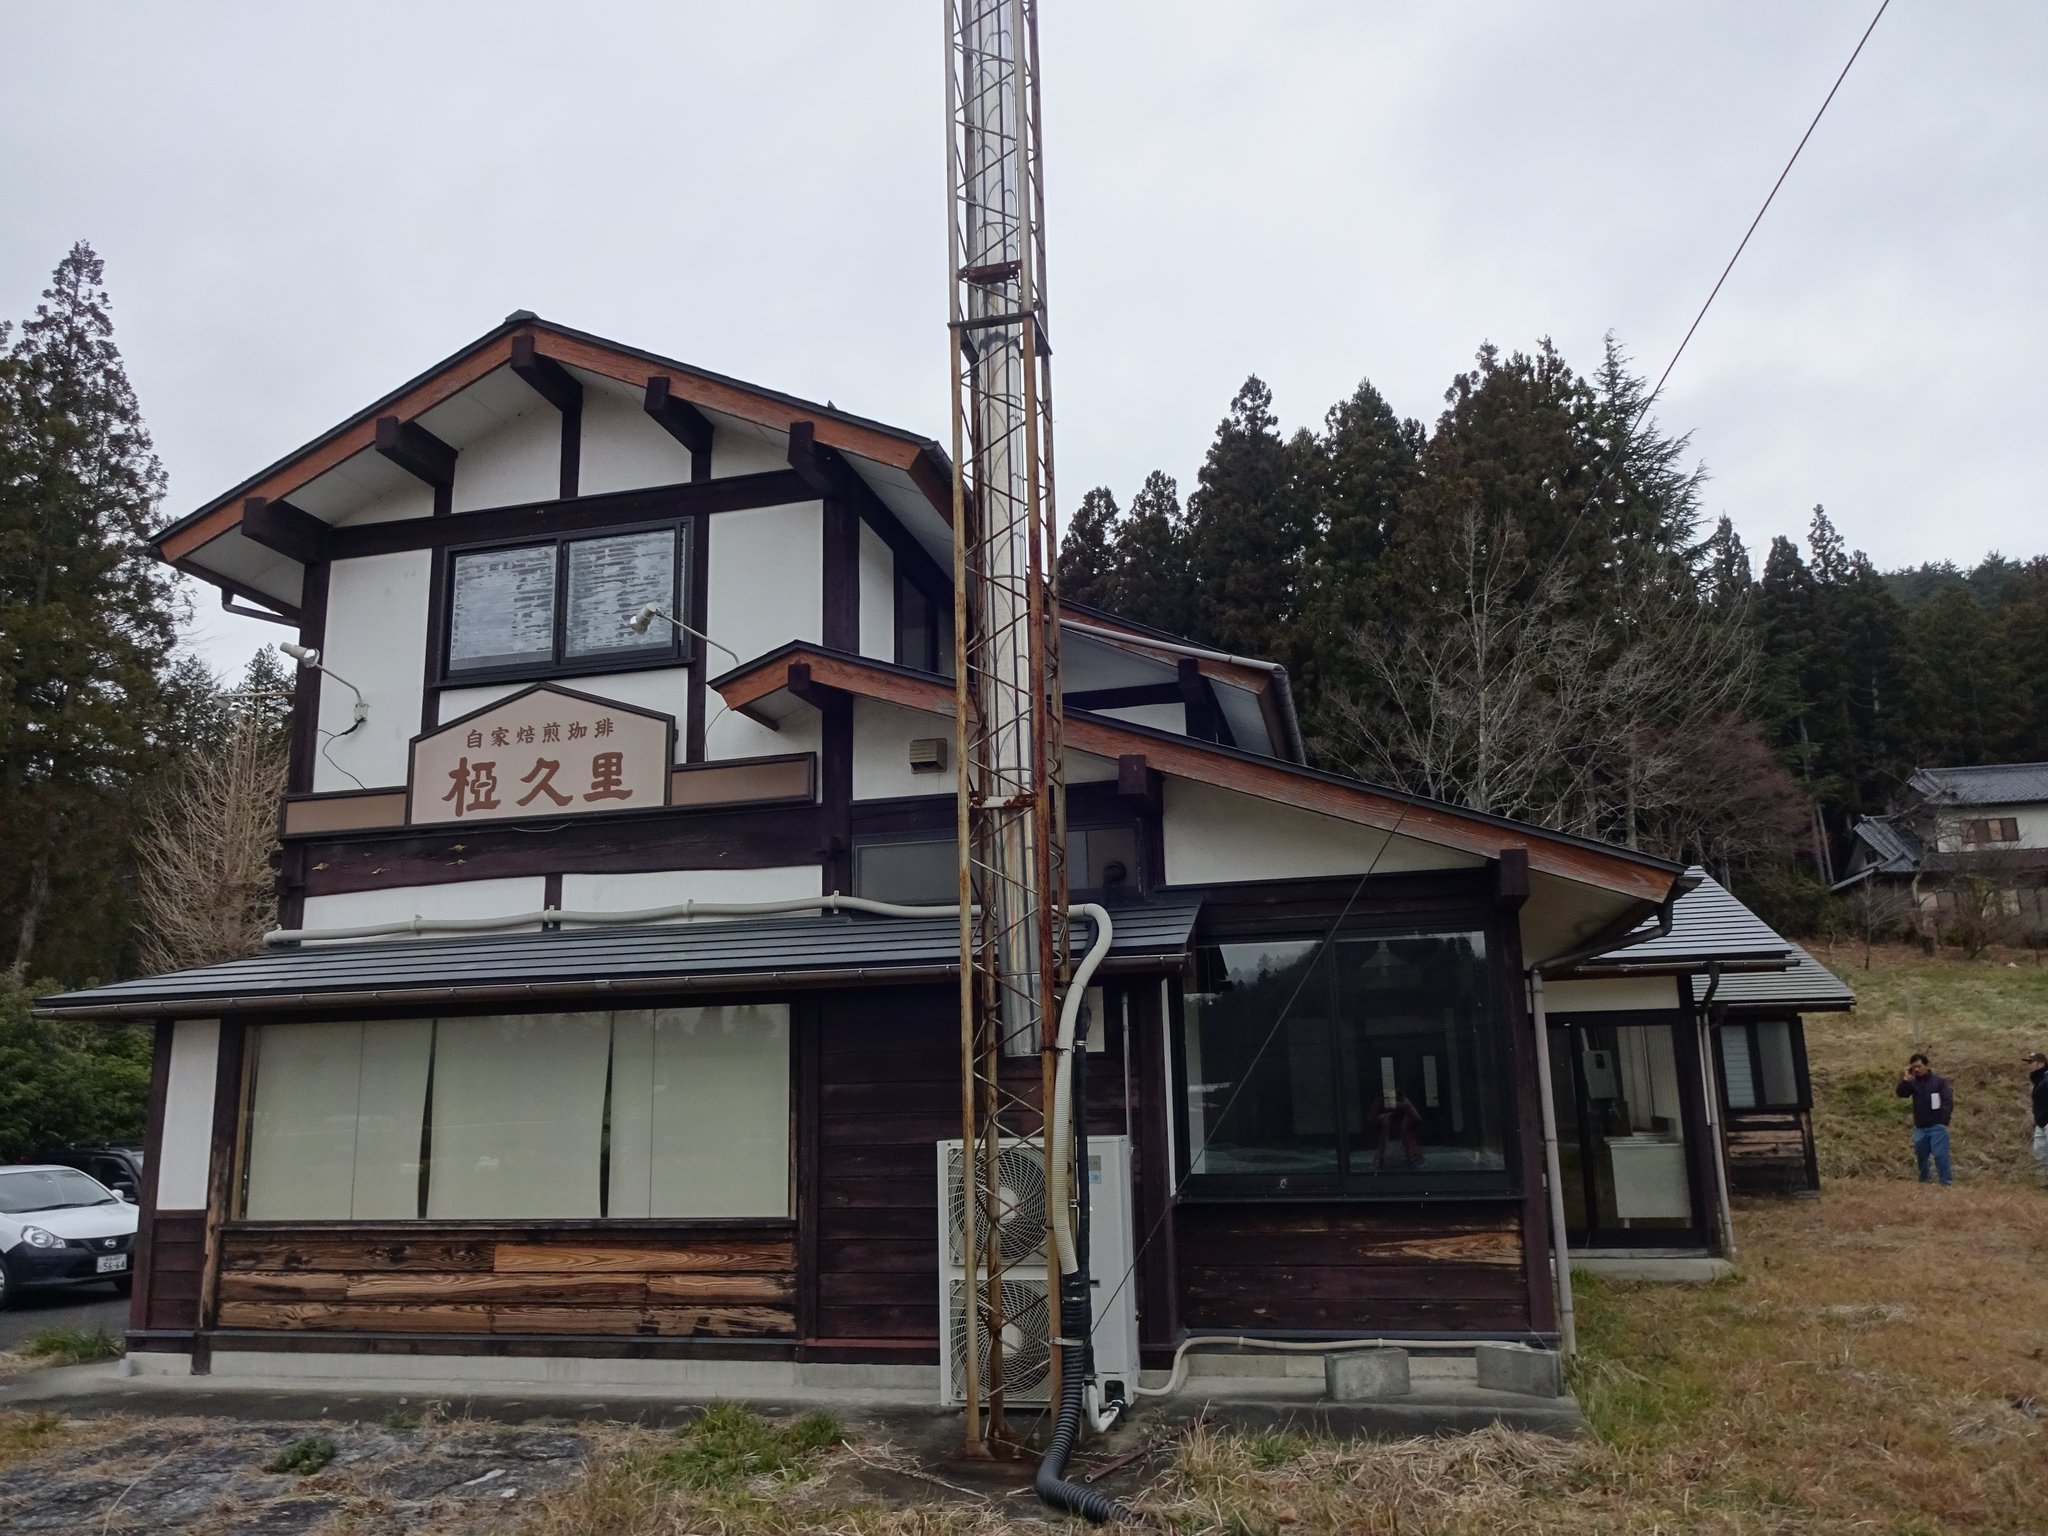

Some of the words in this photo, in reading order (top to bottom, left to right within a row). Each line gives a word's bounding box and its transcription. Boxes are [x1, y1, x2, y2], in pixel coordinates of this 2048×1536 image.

[466, 717, 614, 749] 自家焙煎珈琲
